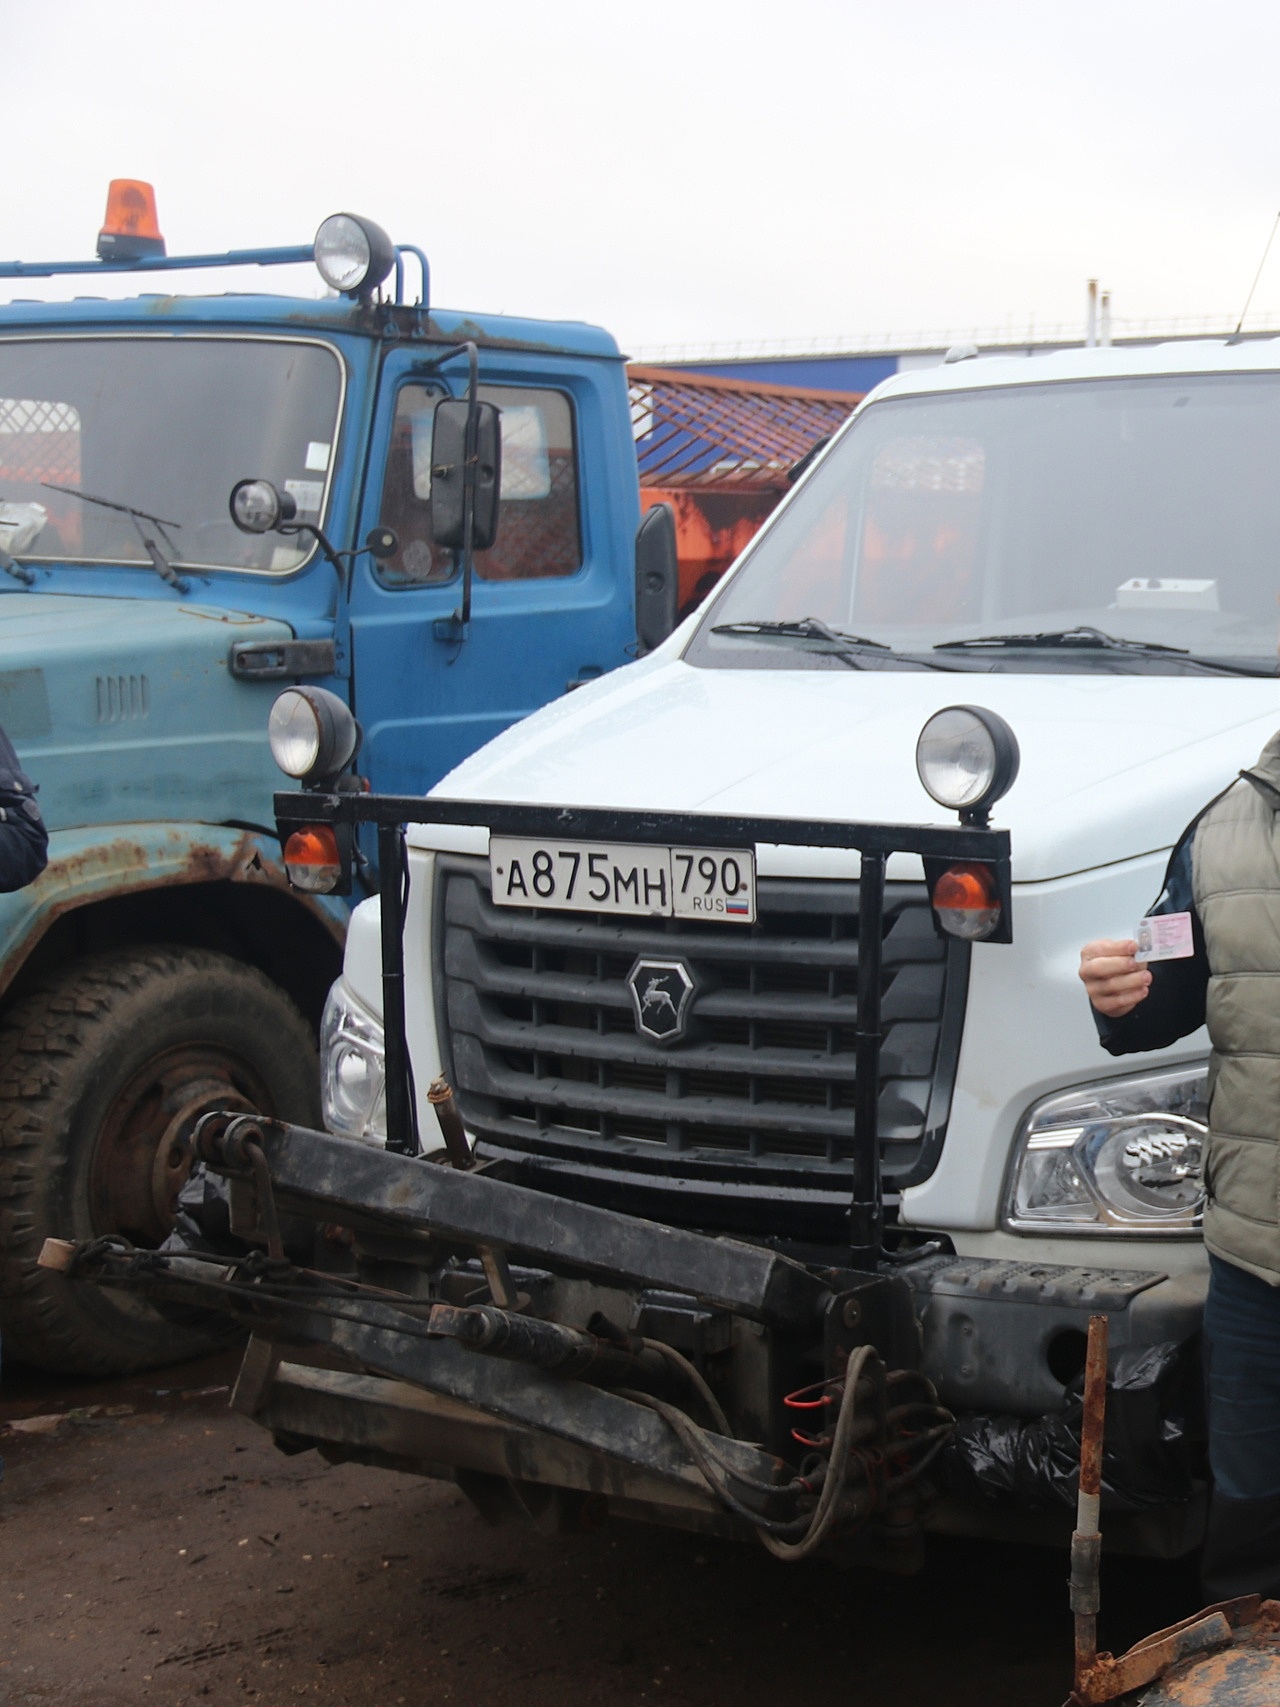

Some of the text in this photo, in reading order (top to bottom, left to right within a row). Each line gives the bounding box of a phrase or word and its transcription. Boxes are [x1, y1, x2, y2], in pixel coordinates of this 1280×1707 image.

[507, 850, 741, 906] А875МН 790
[693, 897, 725, 912] RUS
